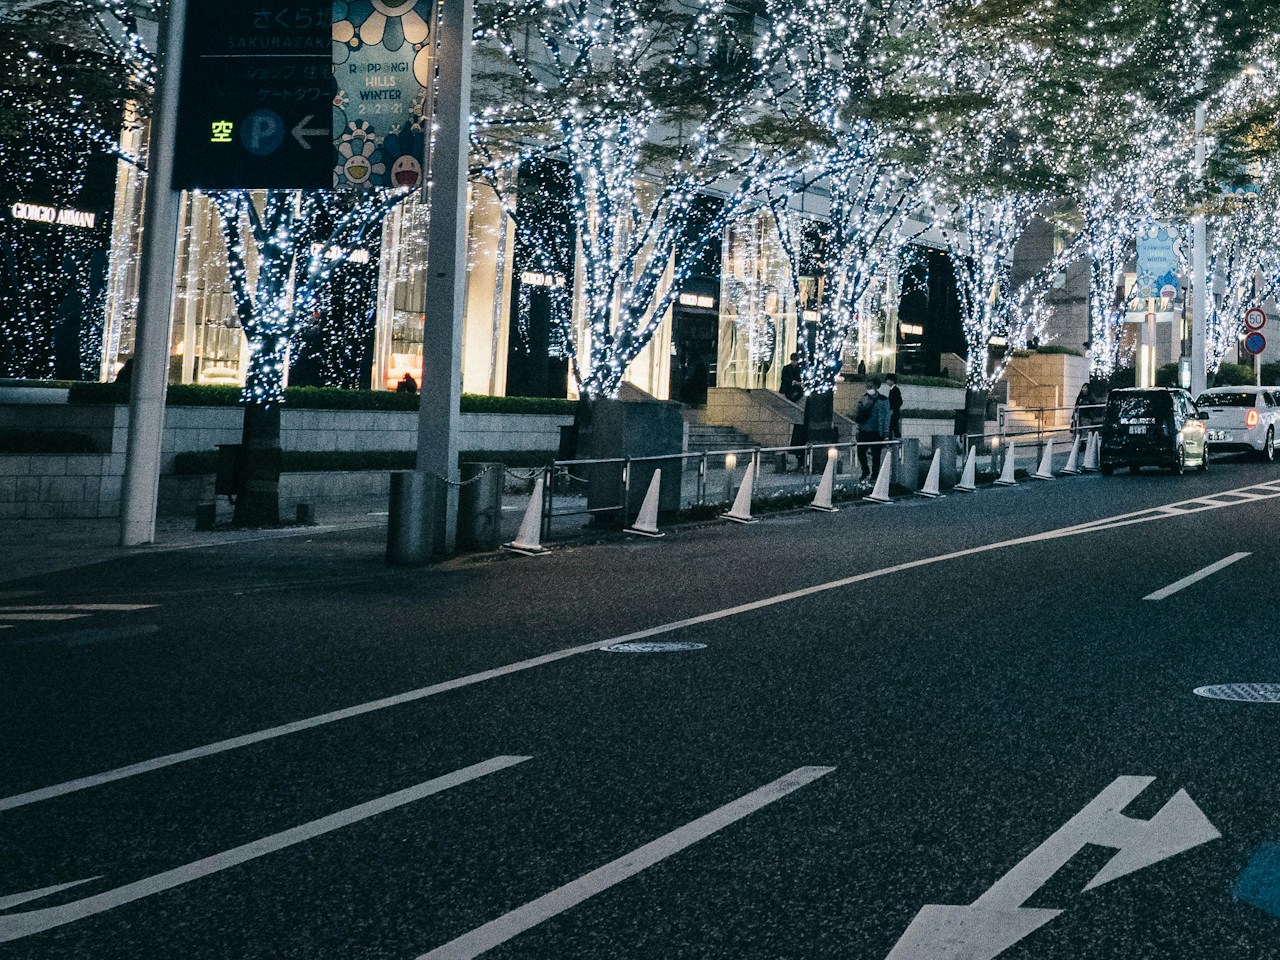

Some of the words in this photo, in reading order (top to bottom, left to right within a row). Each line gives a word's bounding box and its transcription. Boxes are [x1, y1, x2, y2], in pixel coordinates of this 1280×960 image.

[365, 76, 396, 87] HILLS
[360, 90, 402, 100] WINTER
[211, 120, 233, 142] 空
[253, 116, 276, 149] P
[12, 202, 56, 222] GIORGIO
[56, 209, 95, 228] ARMANI
[1250, 315, 1261, 324] 50
